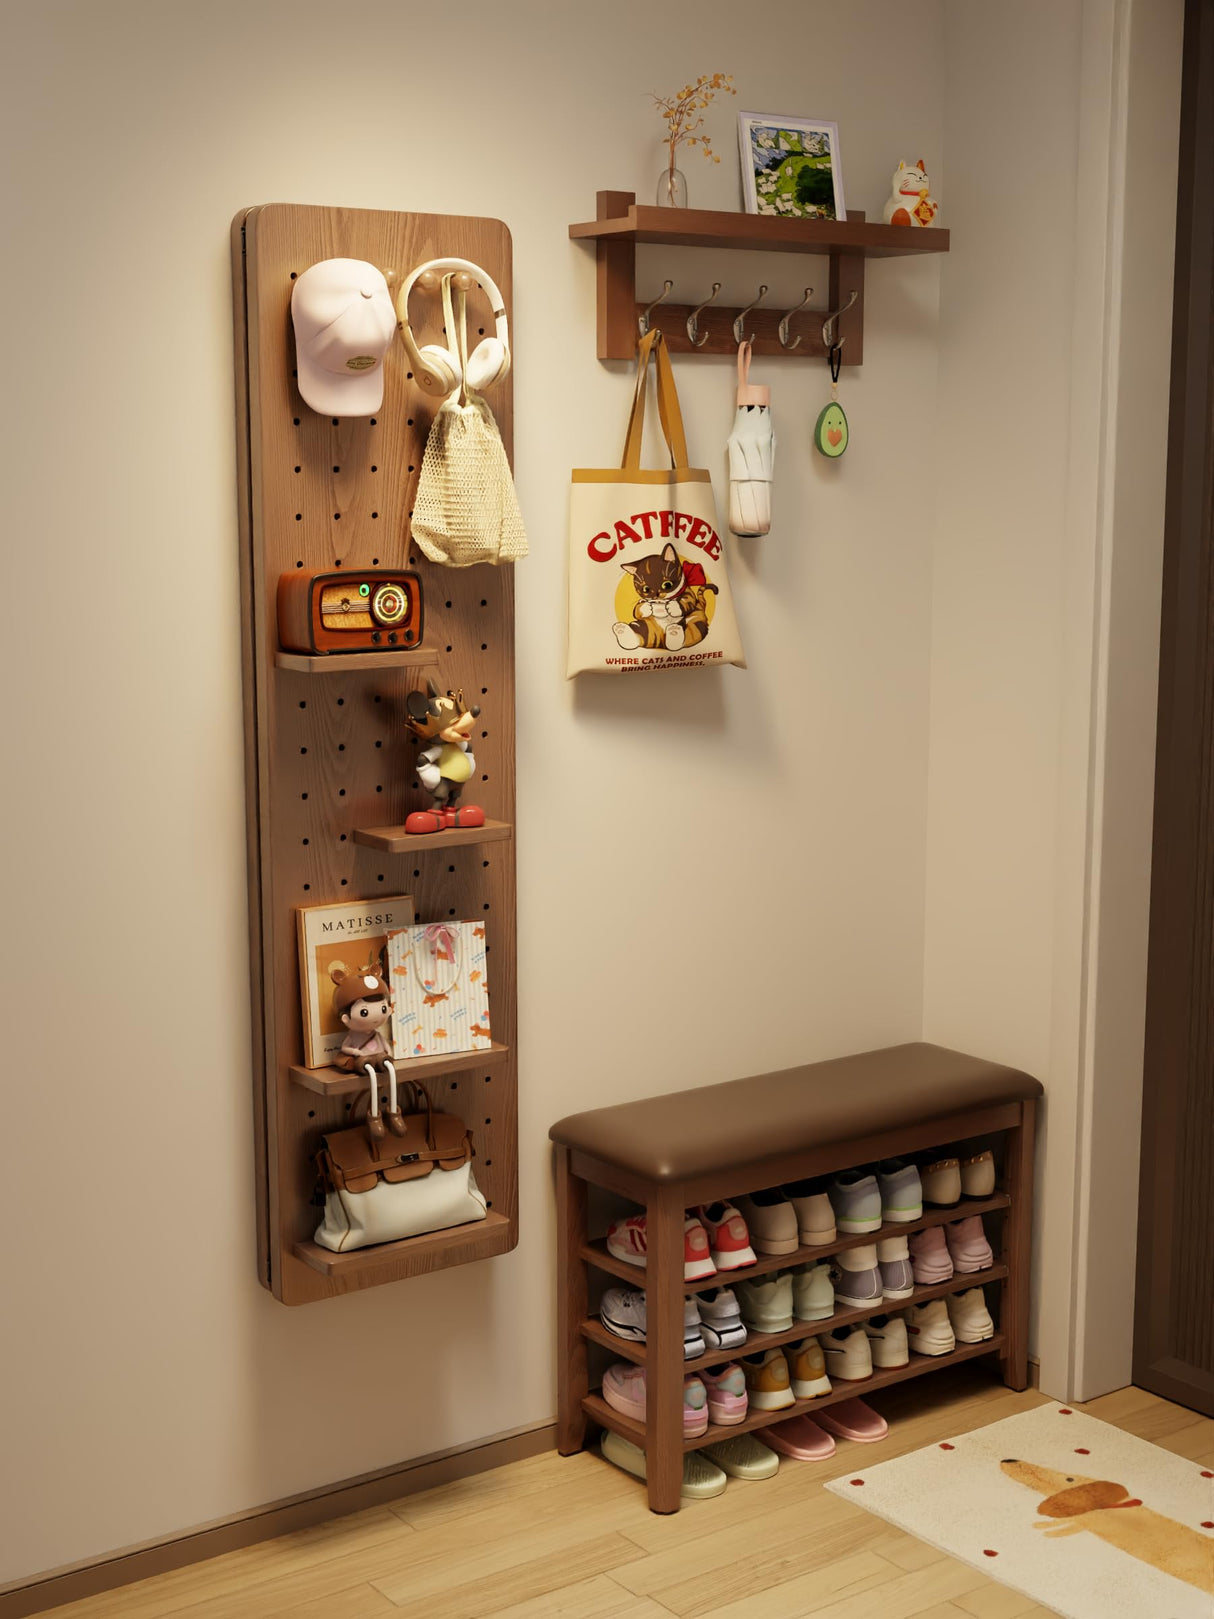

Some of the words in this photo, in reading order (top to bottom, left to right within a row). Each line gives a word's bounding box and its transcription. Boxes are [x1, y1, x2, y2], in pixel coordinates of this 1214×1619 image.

[587, 510, 723, 563] CATFFEE
[605, 657, 639, 665] WHERE
[642, 656, 664, 665] CATS
[666, 655, 687, 663] AND
[689, 651, 723, 661] COFFEE
[621, 665, 651, 673] BRING
[322, 913, 393, 932] MATISSE
